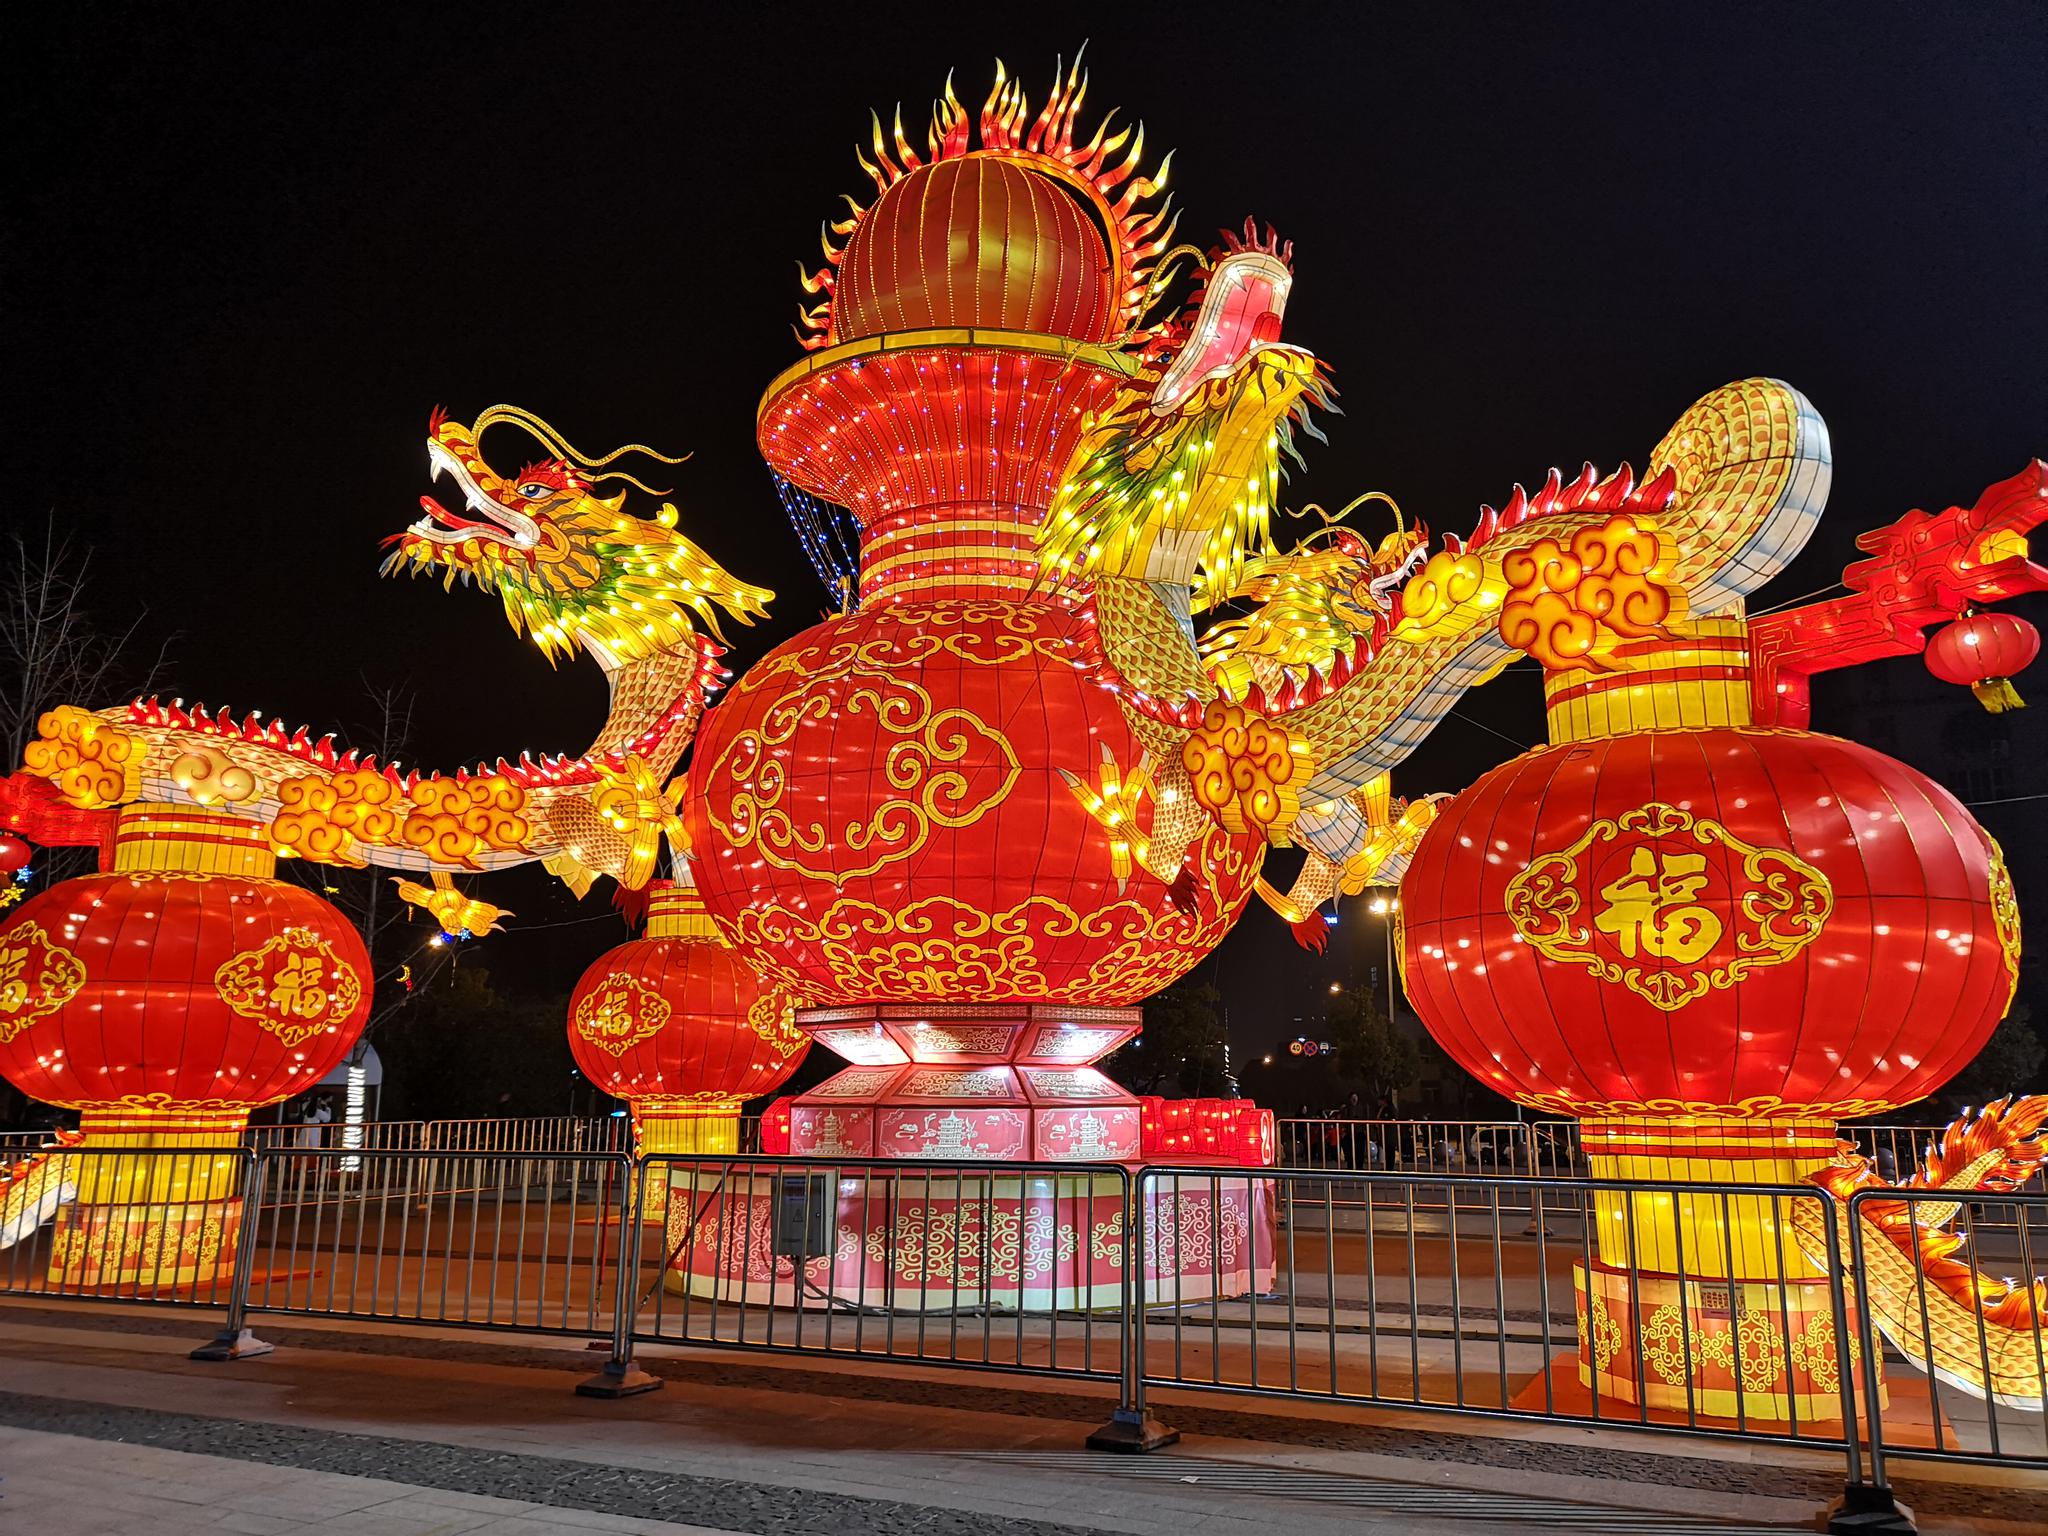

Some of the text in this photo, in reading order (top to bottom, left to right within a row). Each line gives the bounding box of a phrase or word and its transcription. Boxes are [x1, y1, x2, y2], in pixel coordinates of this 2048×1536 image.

[1595, 847, 1722, 963] 福
[269, 952, 327, 1019] 福
[596, 991, 633, 1036] 福
[1292, 1044, 1301, 1052] 40
